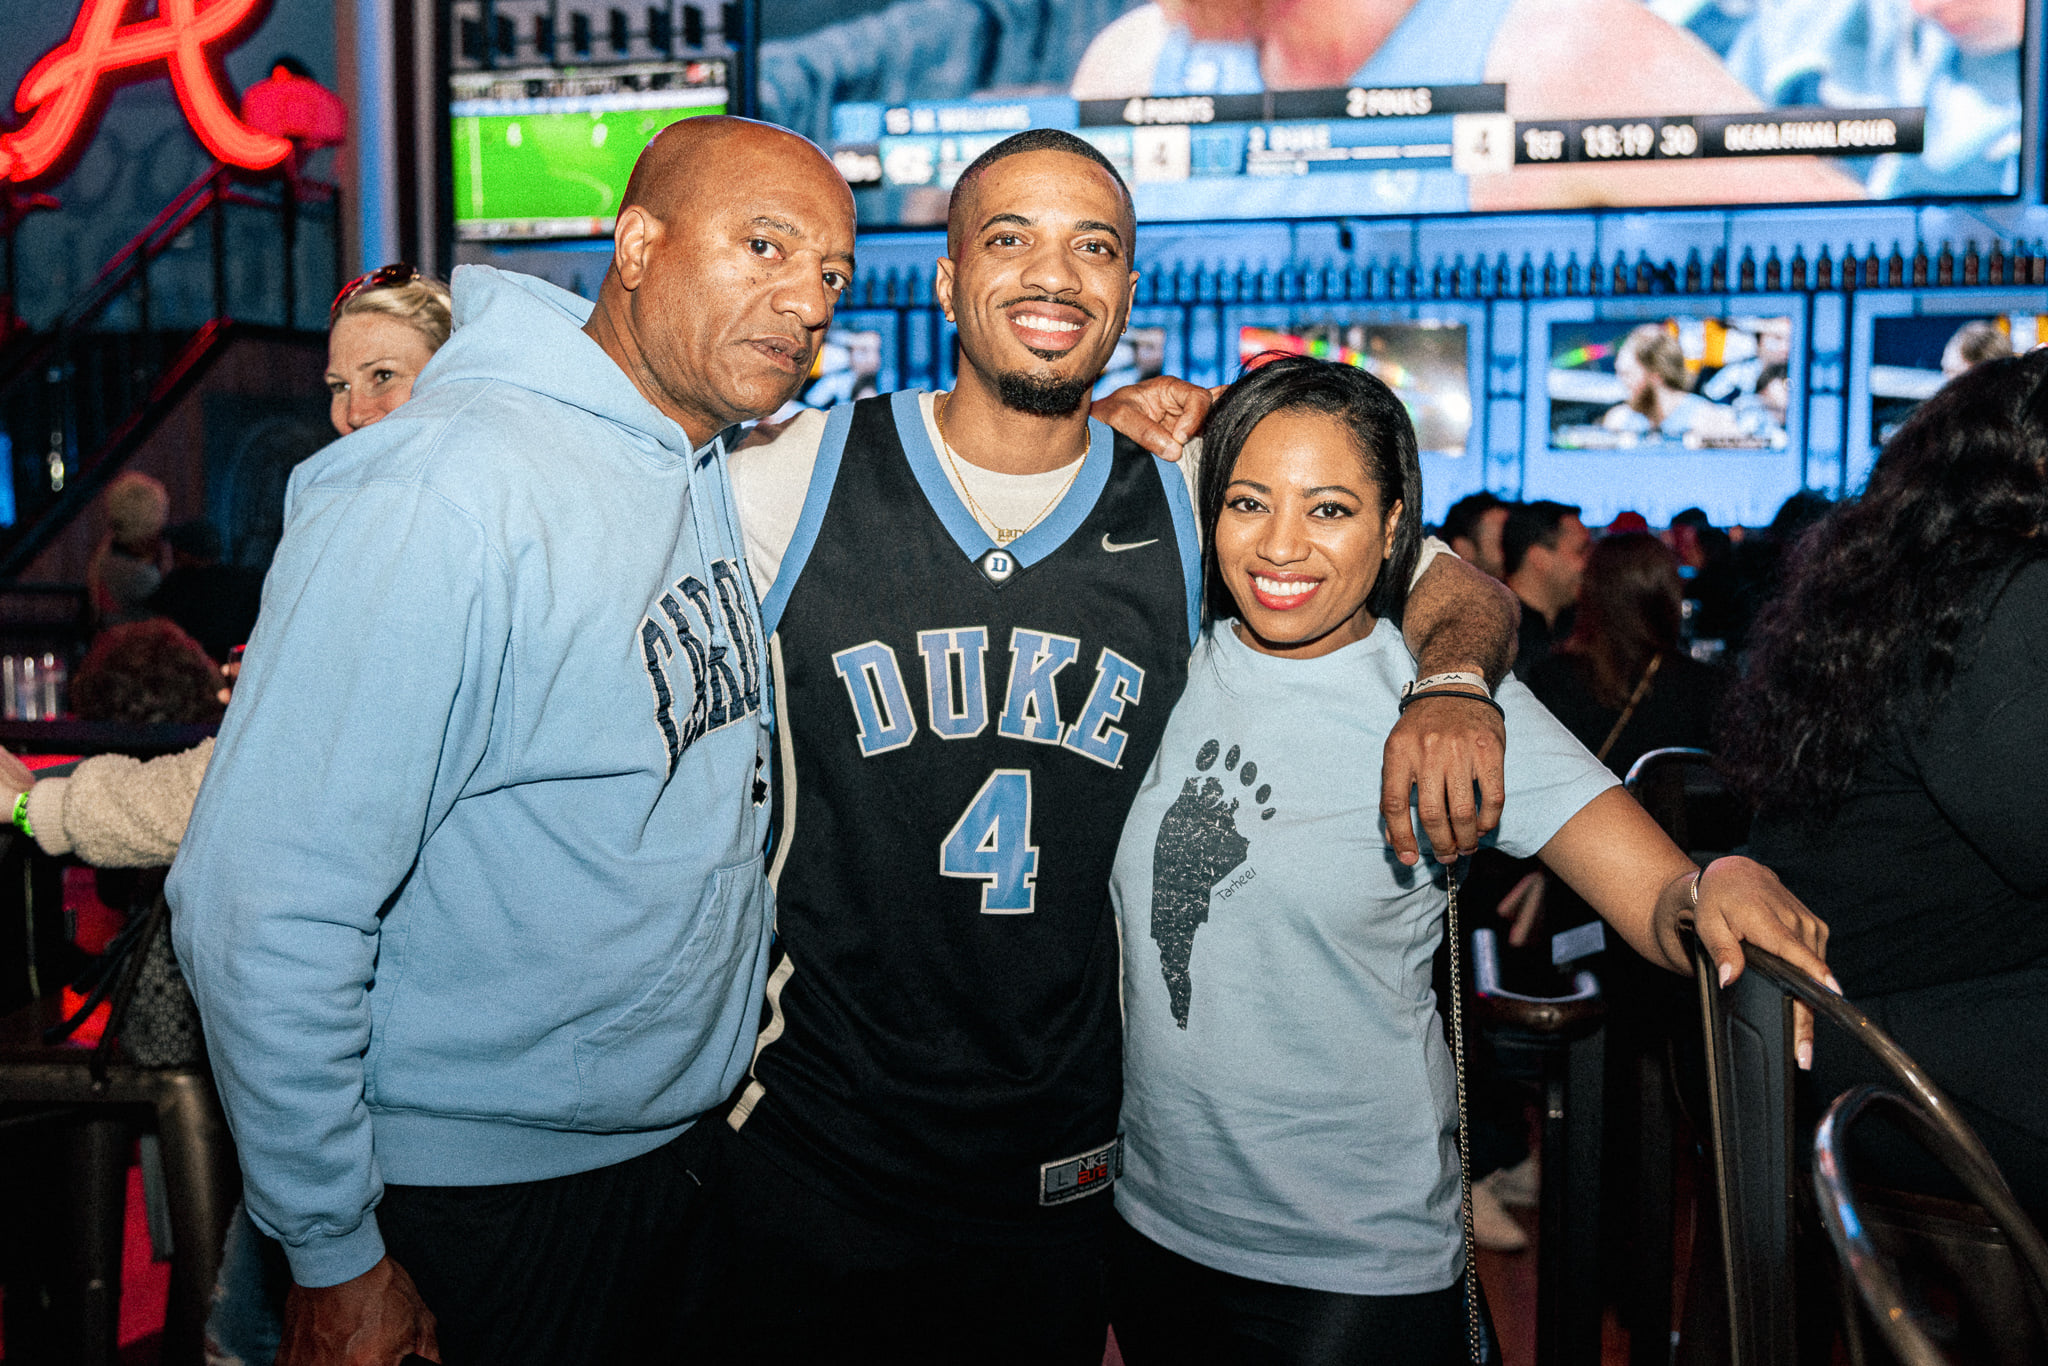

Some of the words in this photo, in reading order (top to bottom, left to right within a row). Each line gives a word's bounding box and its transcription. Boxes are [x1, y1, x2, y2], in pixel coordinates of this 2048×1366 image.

[991, 557, 1007, 573] D
[831, 625, 1146, 769] DUKE
[939, 768, 1040, 914] 4
[1215, 866, 1258, 902] Tarheel
[1078, 1151, 1108, 1173] NIKE
